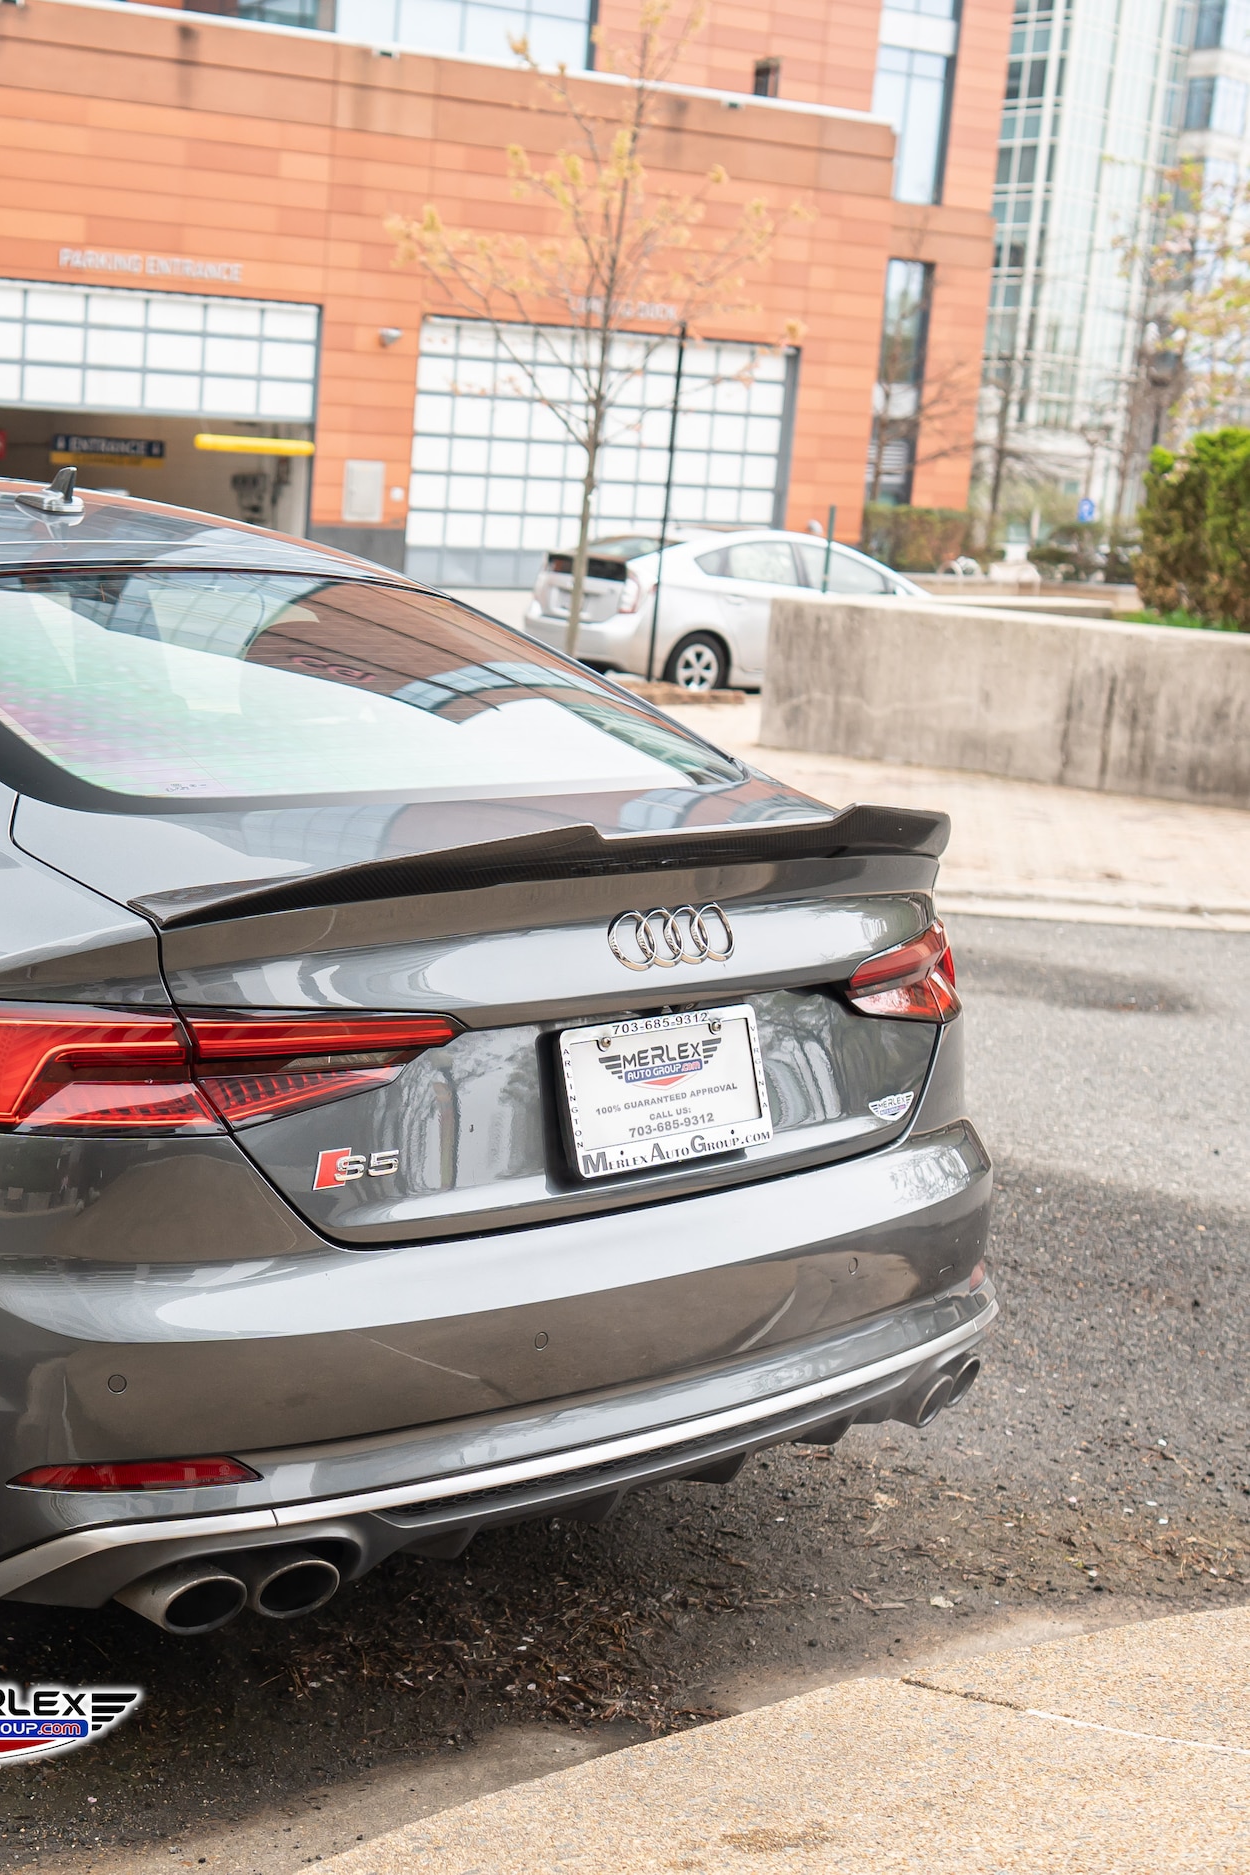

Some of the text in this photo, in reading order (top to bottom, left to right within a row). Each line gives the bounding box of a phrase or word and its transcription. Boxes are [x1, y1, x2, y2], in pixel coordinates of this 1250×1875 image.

[59, 248, 244, 282] PARKING ENTRANCE
[612, 1012, 708, 1035] 703-685-9312
[623, 1042, 702, 1069] MERLEX
[749, 1025, 768, 1109] VIRGINIA
[627, 1069, 652, 1082] AUTO
[562, 1049, 584, 1149] ARLINGTON
[595, 1083, 738, 1116] 100% GUARANTEED APPROVAL
[649, 1107, 692, 1121] CALL US:
[629, 1112, 715, 1138] 703-685-9312
[334, 1149, 400, 1182] S5
